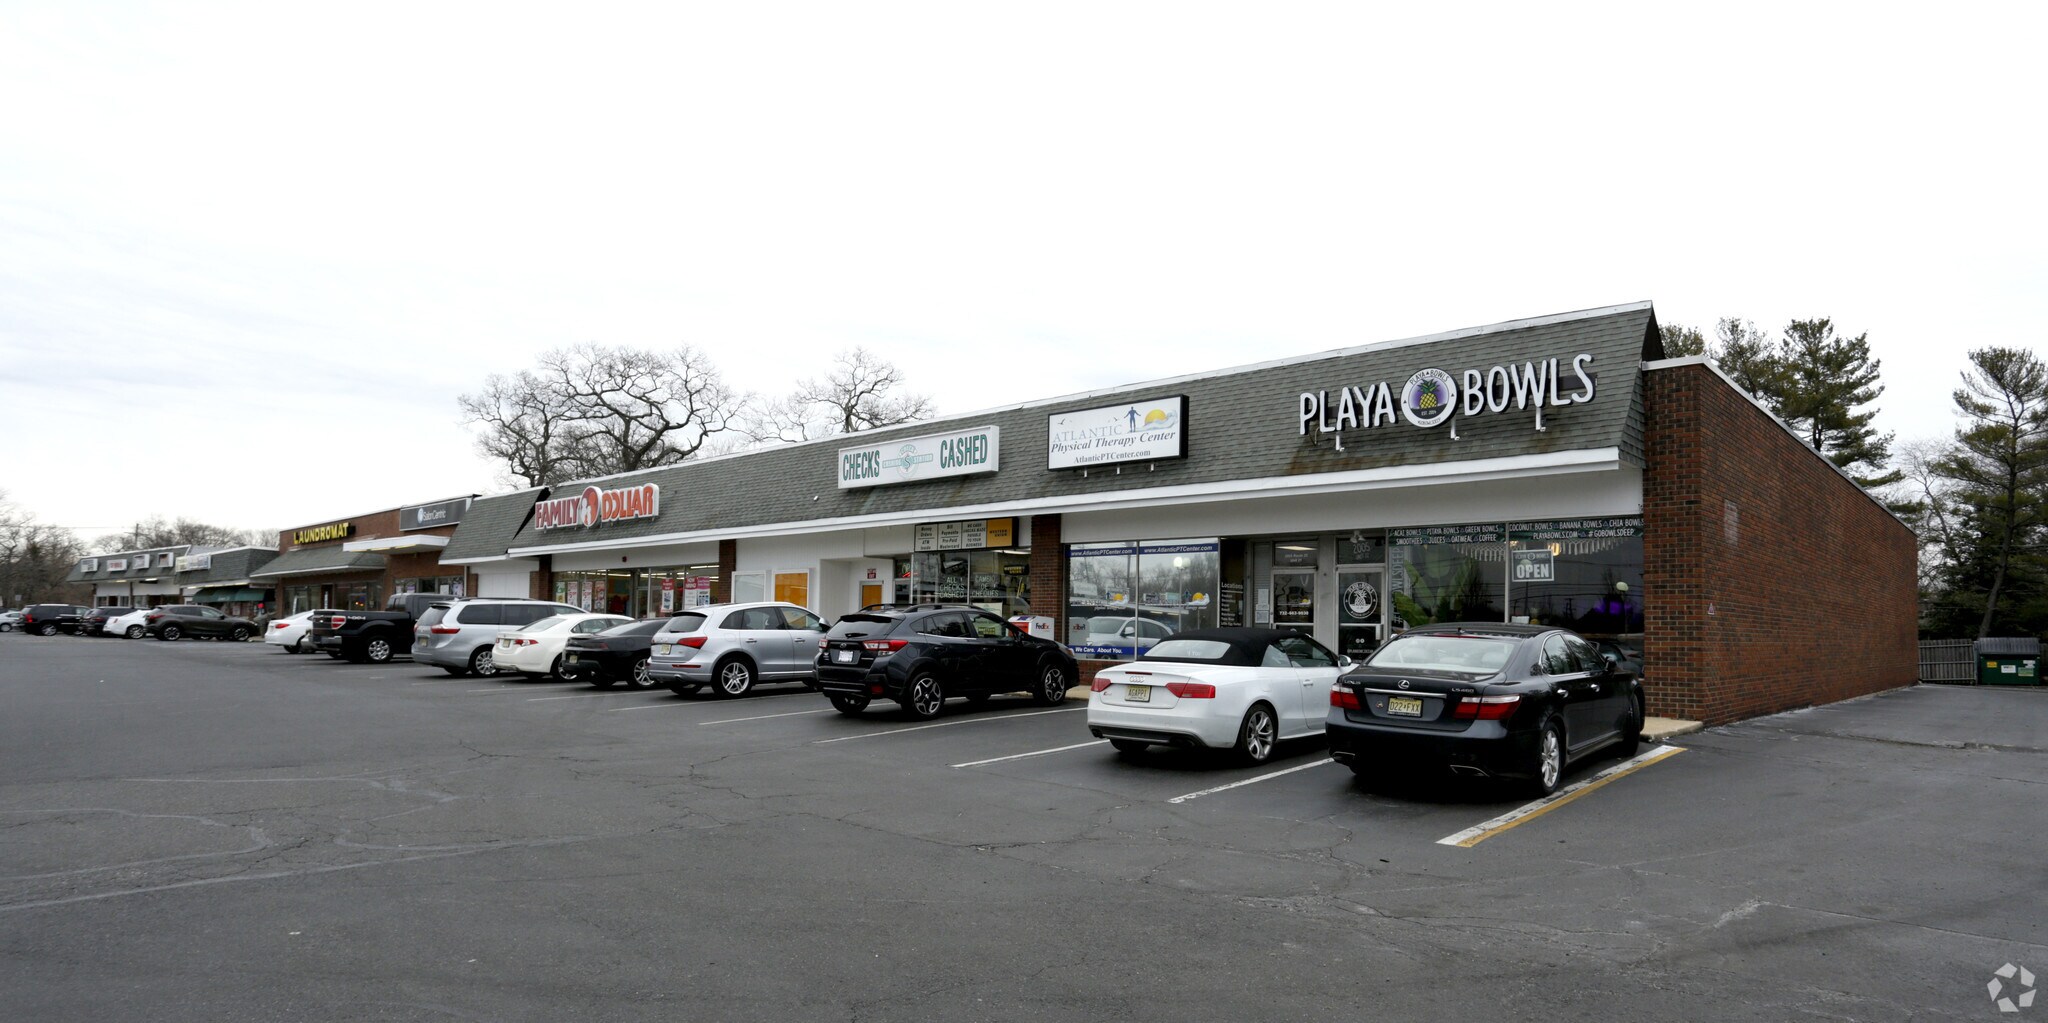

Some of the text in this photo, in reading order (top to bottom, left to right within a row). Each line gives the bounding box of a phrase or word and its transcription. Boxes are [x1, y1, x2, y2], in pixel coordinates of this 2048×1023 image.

[1410, 369, 1450, 385] PLAYA BOWLS
[1300, 354, 1595, 435] PLAYA BOWLS
[1053, 424, 1122, 442] ATLANTIC
[1051, 431, 1175, 454] Physical Therapy Center
[843, 434, 988, 481] CHECKS CASHED
[1074, 450, 1151, 464] AtlanticPTCenter.com
[535, 485, 654, 529] FAMILY DOLLAR
[1406, 528, 1421, 536] BOWLS
[1465, 525, 1480, 533] GREEN
[1482, 524, 1499, 532] BOWLS
[1509, 523, 1532, 532] COCONUT
[1535, 522, 1553, 530] BOWLS
[1560, 521, 1581, 529] BANANA
[1583, 520, 1602, 528] BOWLS
[1609, 519, 1624, 527] CHIA
[294, 522, 349, 544] LAUNDROMAT
[1428, 536, 1446, 544] JUICES
[1451, 535, 1473, 543] OATMEAL
[1478, 534, 1497, 542] COFFEE
[1533, 531, 1578, 540] PLAYABOWLS.COM
[1071, 548, 1132, 556] www.AtlanticPTCenter.com
[1144, 545, 1213, 553] www.AtlanticPTCenter.com
[1516, 563, 1549, 578] OPEN
[975, 575, 995, 583] CAMBIO
[971, 590, 999, 598] CHEQUES
